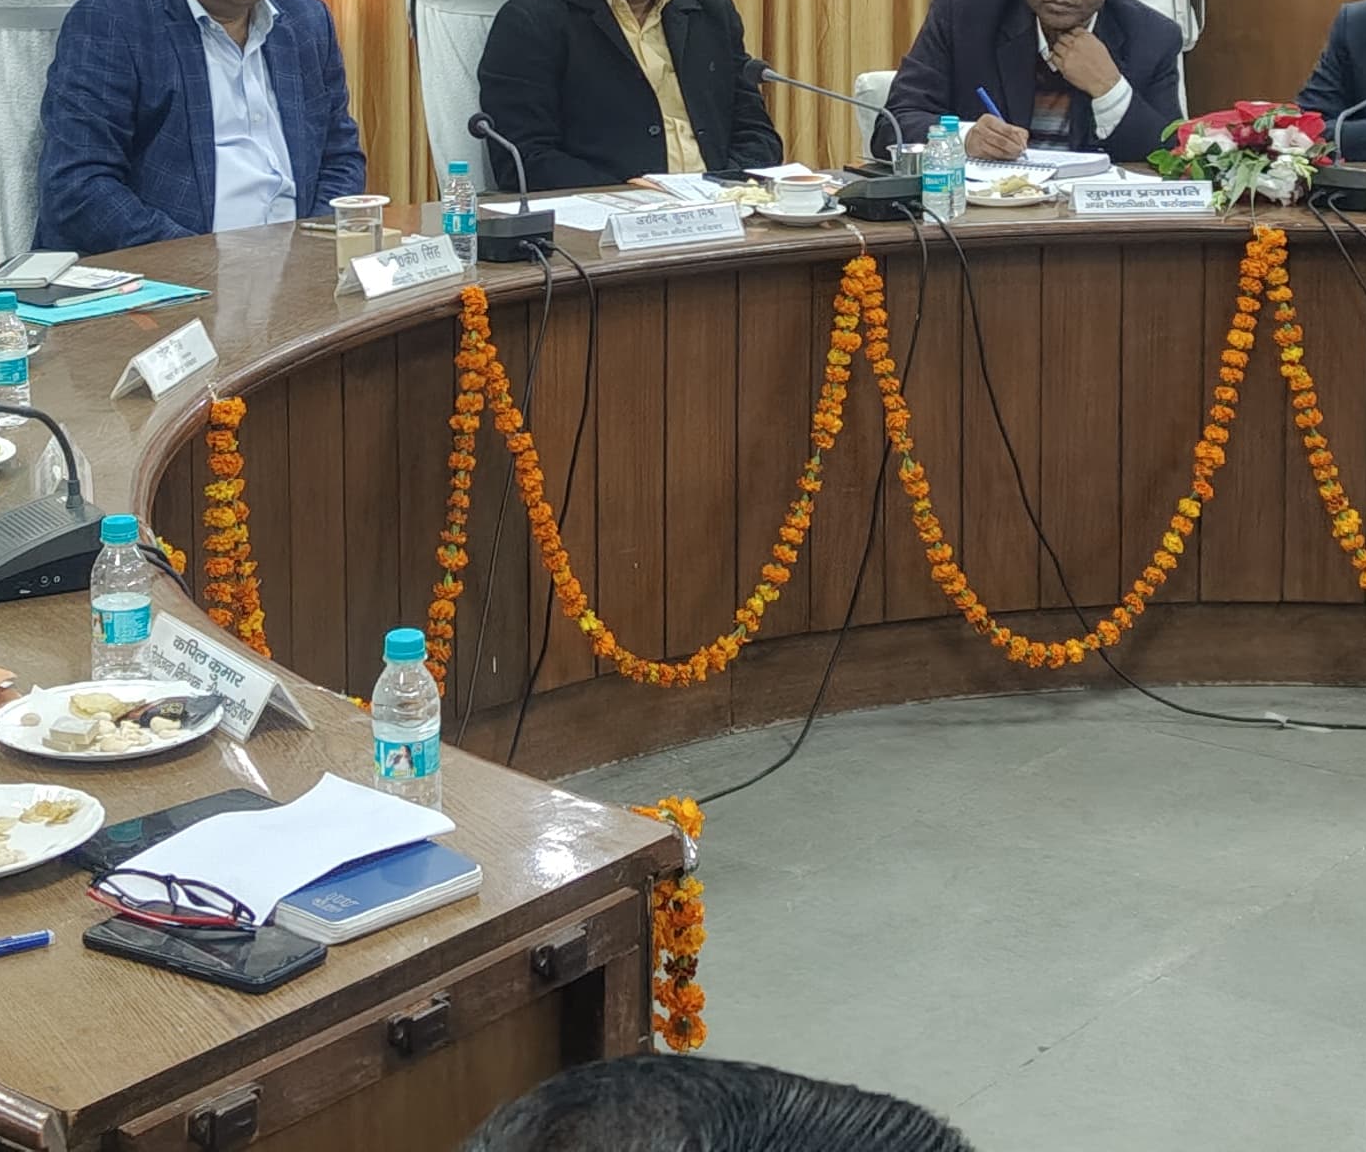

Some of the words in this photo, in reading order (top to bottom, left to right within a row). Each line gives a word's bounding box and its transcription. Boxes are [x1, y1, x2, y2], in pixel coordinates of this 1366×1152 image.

[1085, 189, 1133, 201] सुभाष
[1137, 185, 1201, 199] प्रजापति
[173, 635, 210, 666] कपिल
[207, 656, 246, 689] कुमार
